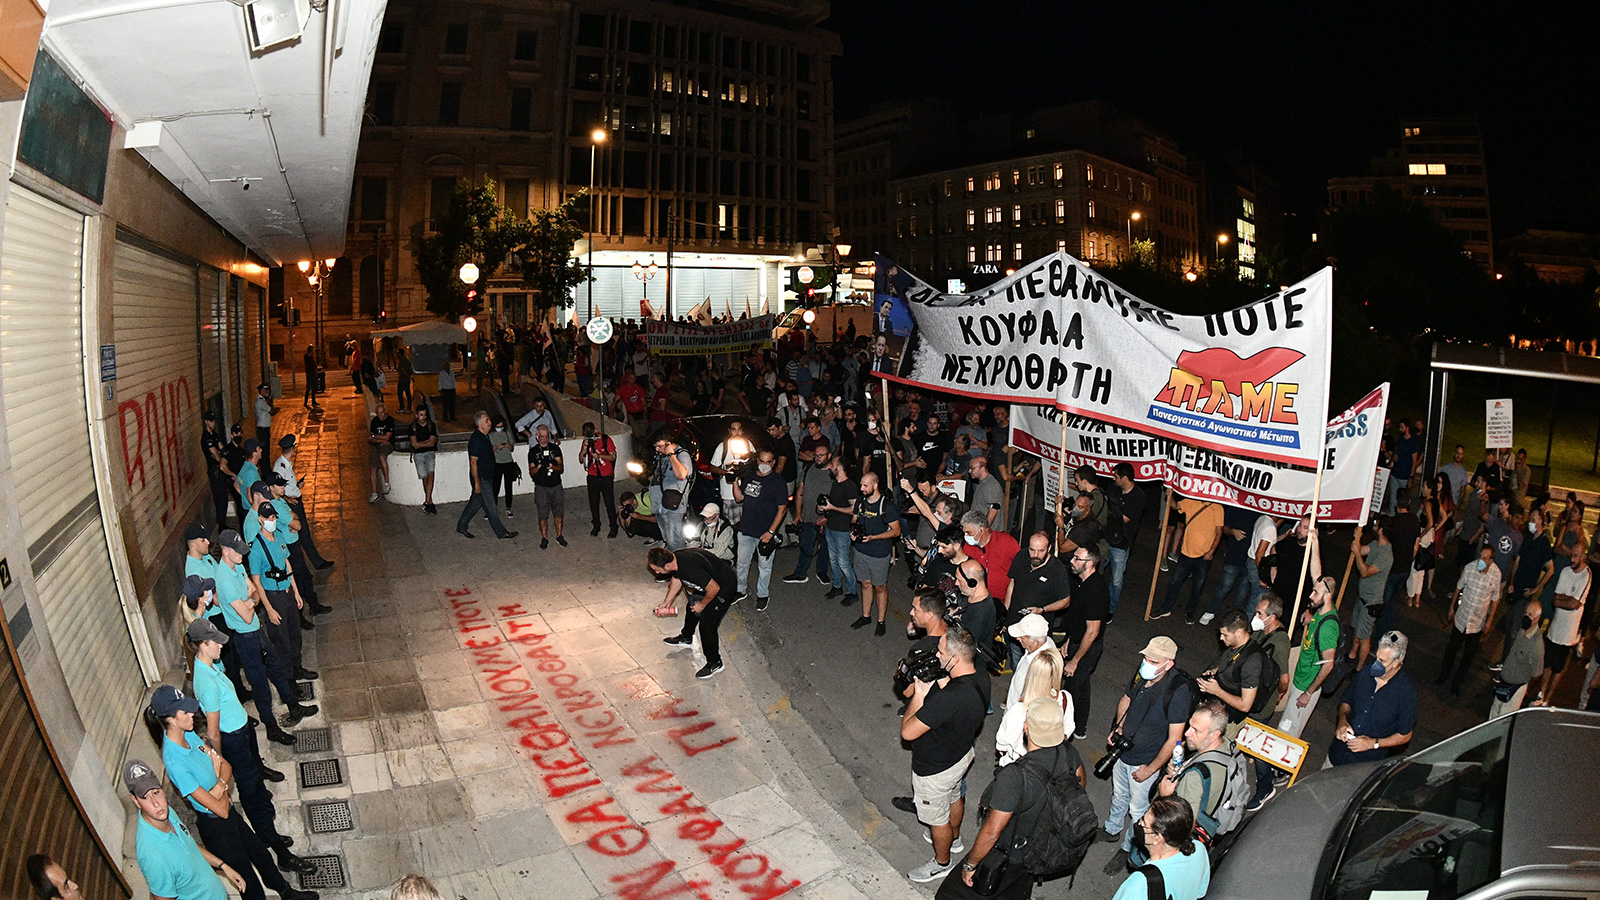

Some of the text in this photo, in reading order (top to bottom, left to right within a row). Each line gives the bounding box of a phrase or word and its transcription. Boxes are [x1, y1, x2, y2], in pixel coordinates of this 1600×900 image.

[972, 264, 999, 275] ZARA
[1203, 287, 1307, 338] ΠΟΤΕ
[1152, 407, 1295, 444] Πανεργατικό Αγωνιστικό Μέτωπο
[1040, 443, 1118, 474] ΣΥΝΔΙΚΑΤ
[1140, 462, 1239, 501] ΟΙΟΔΟΜΩΝ
[1079, 434, 1103, 454] ΜΕ
[1106, 437, 1183, 464] ΑΠΕΡΓΙΚΟ
[1183, 446, 1273, 492] ΞΕΣΗΚΩΜΟ
[445, 588, 492, 633] ΠΟΤΕ
[466, 636, 602, 797] ΠΕΘΑΝΟΥΜΕ
[565, 797, 650, 857] ΘΑ
